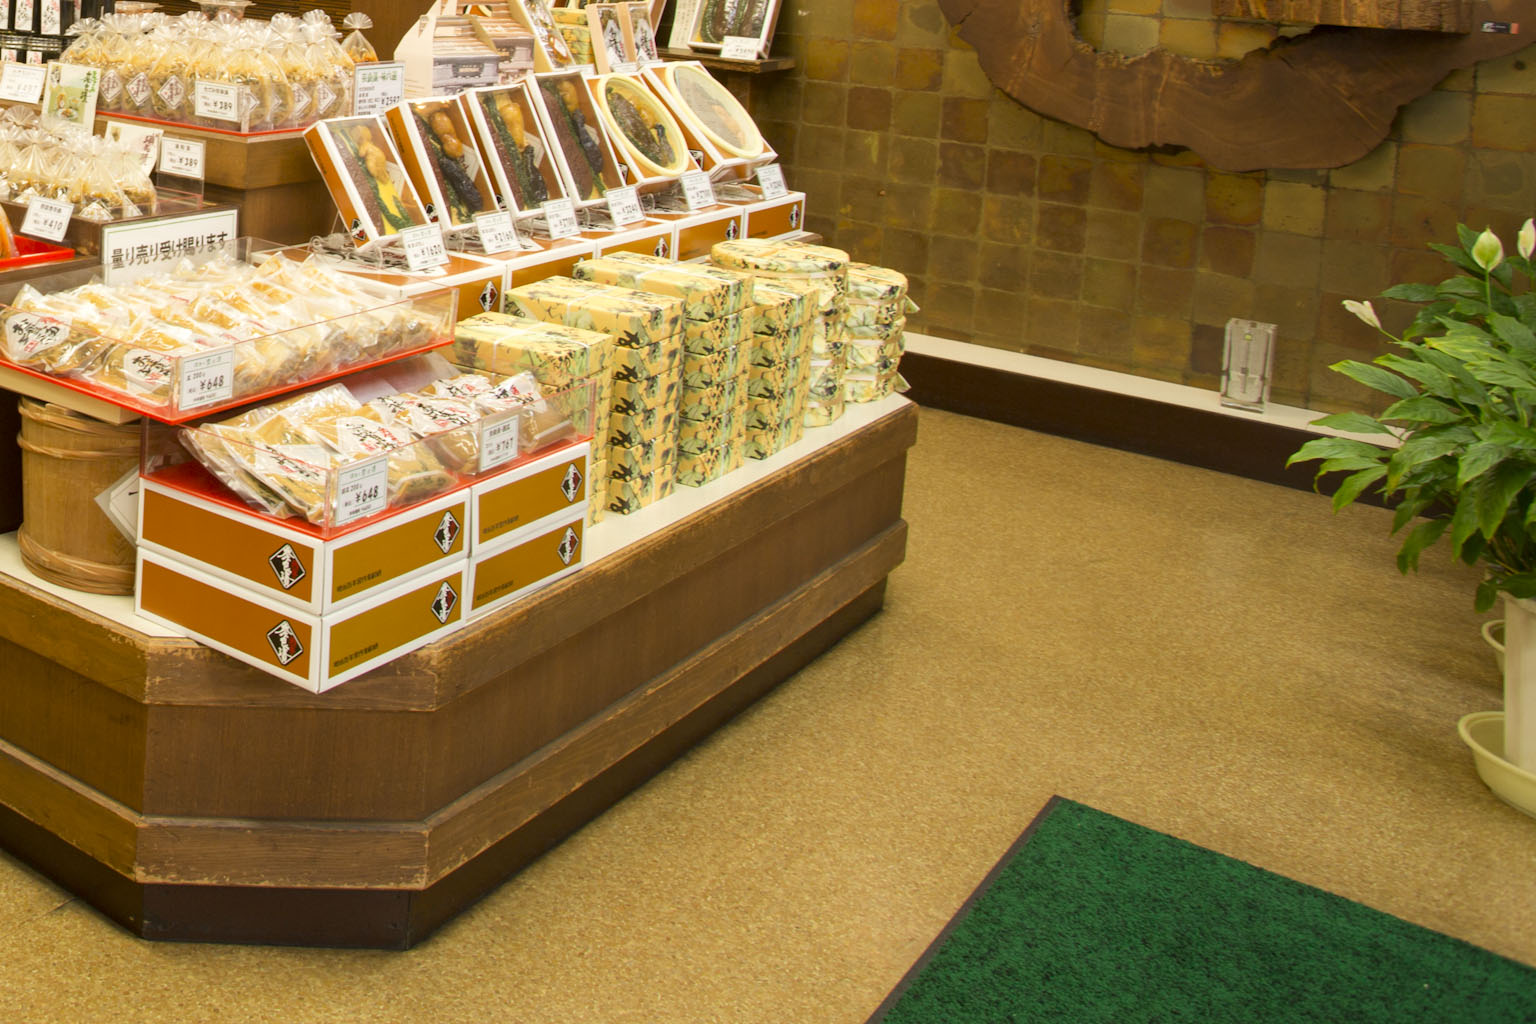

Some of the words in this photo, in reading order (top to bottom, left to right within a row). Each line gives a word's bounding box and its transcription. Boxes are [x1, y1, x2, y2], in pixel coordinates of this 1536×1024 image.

[213, 99, 234, 112] ¥389
[178, 157, 199, 168] ¥389
[43, 219, 64, 231] ¥410
[199, 374, 225, 391] ¥648
[495, 436, 514, 452] ¥767
[355, 484, 379, 504] ¥648
